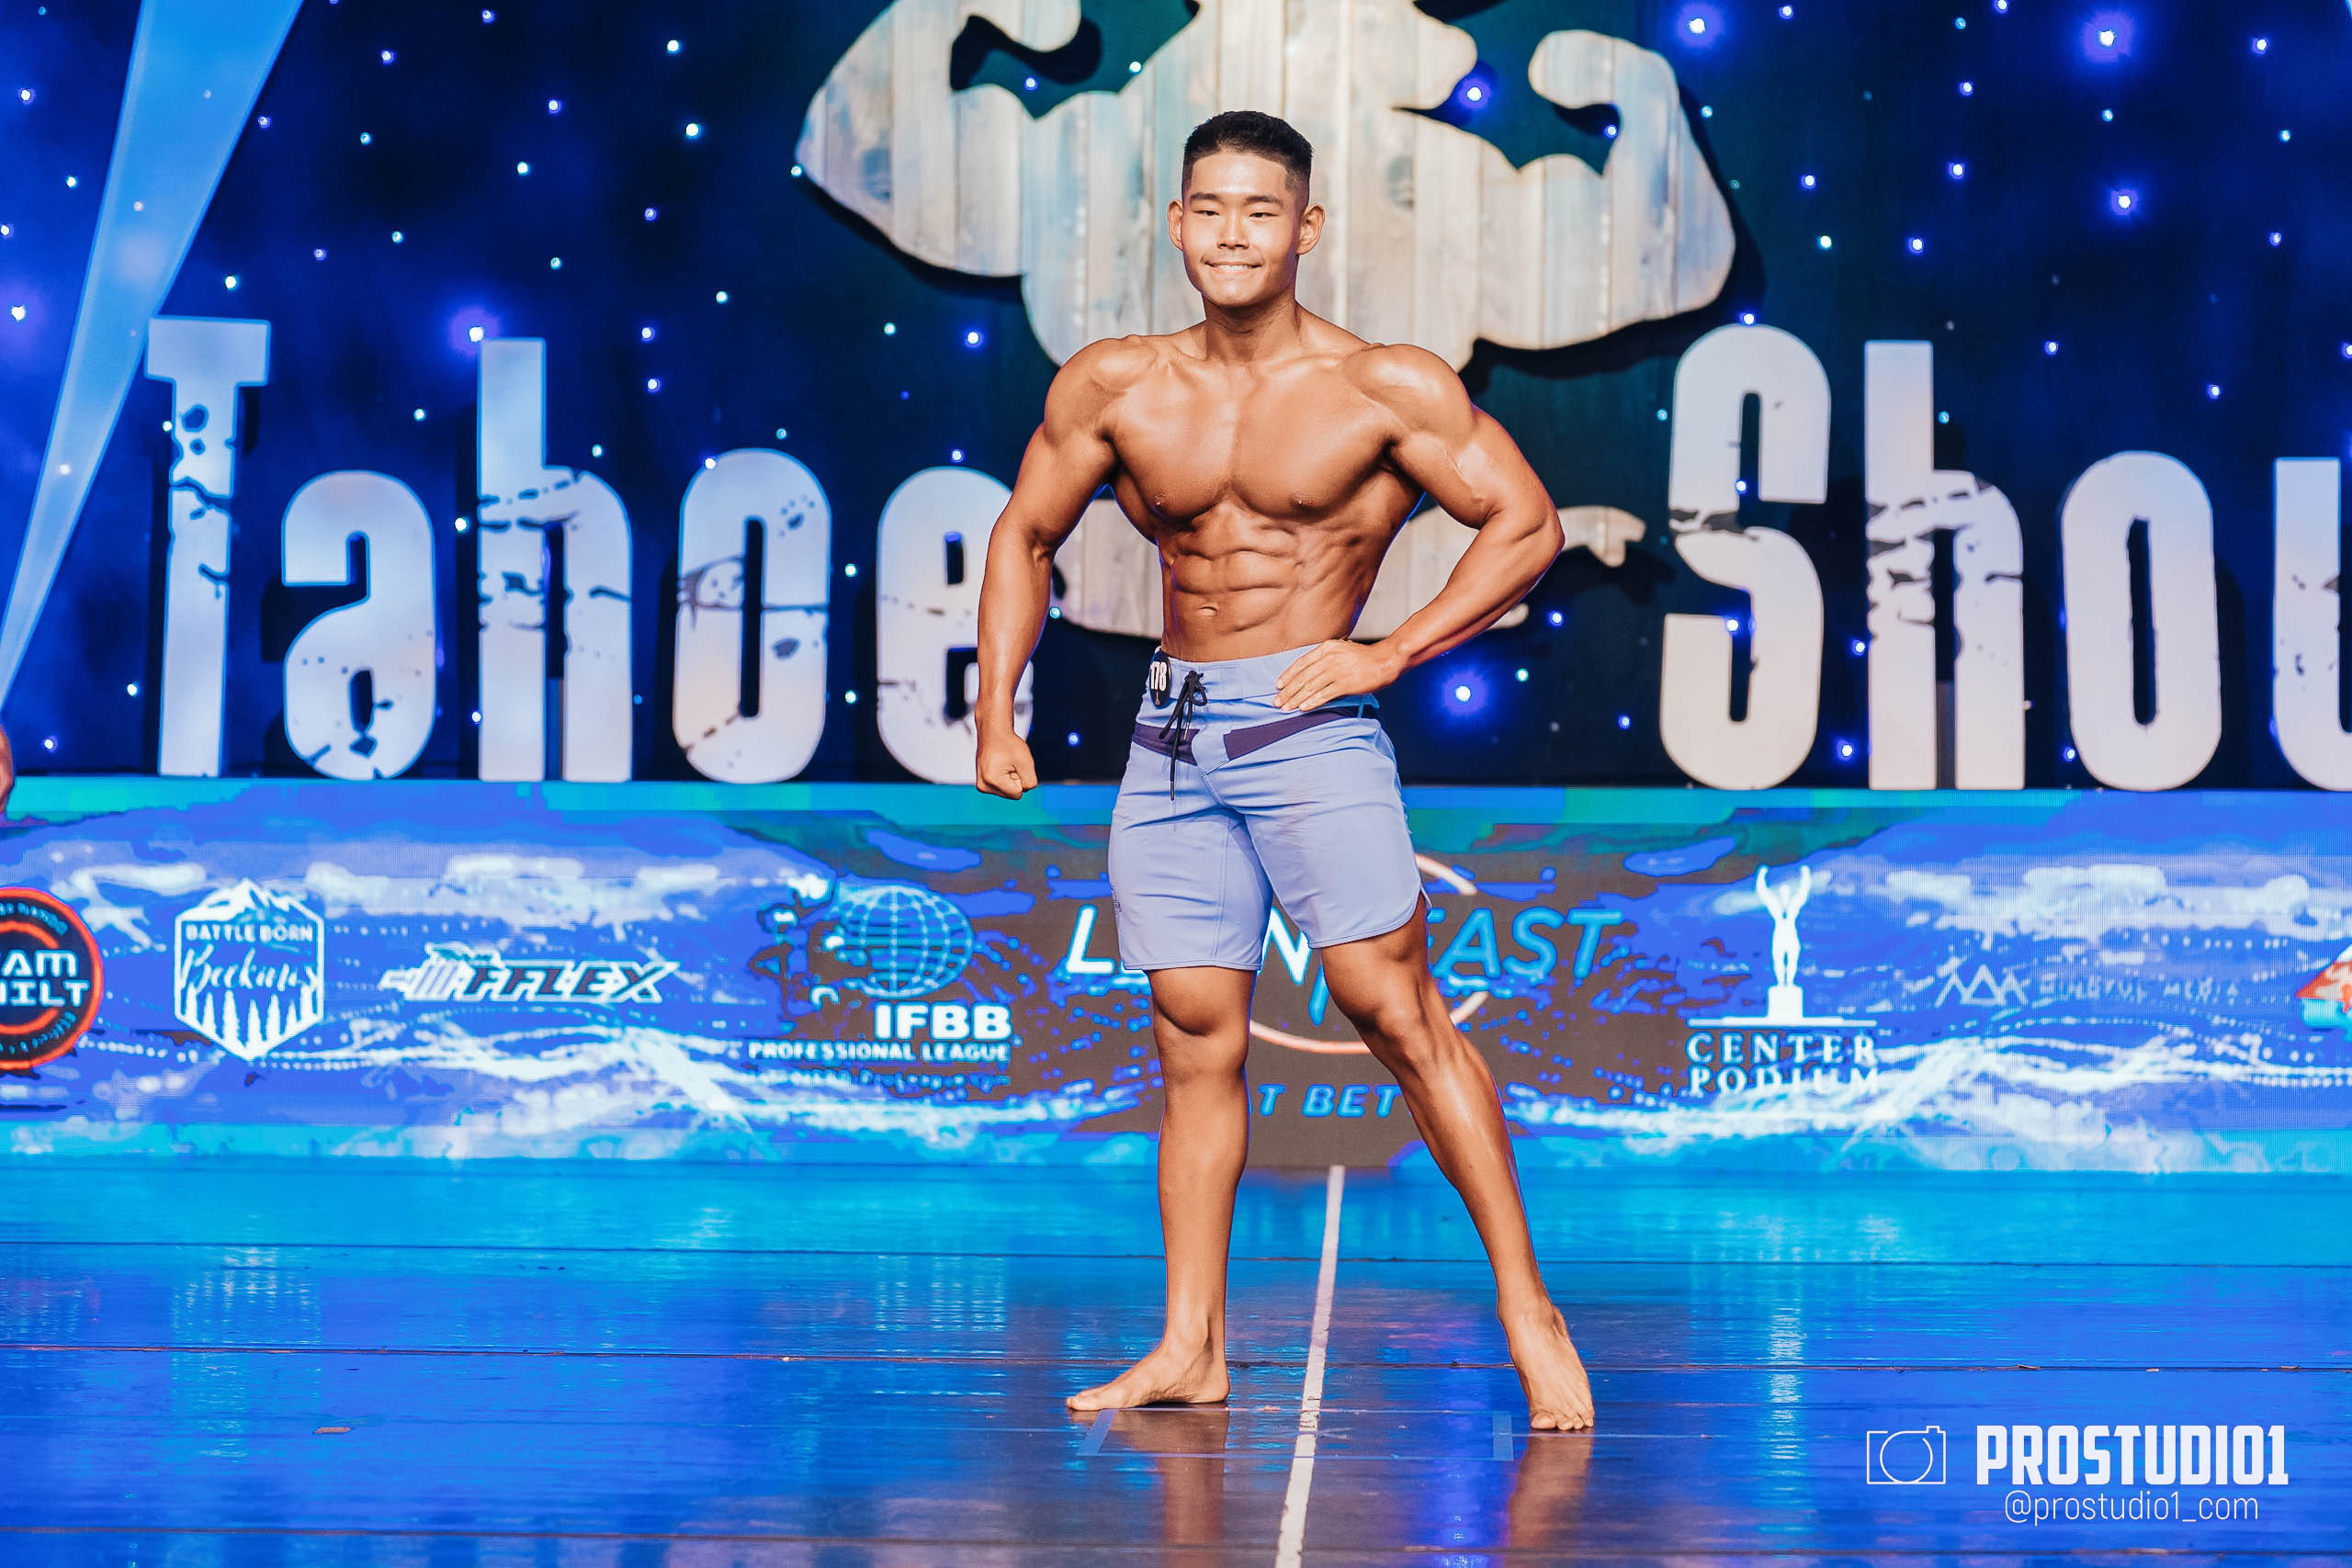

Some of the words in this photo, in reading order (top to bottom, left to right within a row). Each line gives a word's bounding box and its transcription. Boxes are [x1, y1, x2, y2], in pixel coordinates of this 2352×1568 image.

[145, 317, 1034, 785] Tahoe
[1150, 660, 1167, 691] 178
[186, 924, 256, 942] BATTLE
[259, 923, 313, 942] BORN
[0, 950, 77, 977] AM
[875, 1003, 1011, 1040] IFBB
[748, 1041, 916, 1060] PROFESSIONAL
[922, 1041, 1010, 1062] LEAGUE
[1687, 1032, 1879, 1066] CENTER
[1690, 1066, 1880, 1098] PODIUM
[1302, 1084, 1404, 1118] BET
